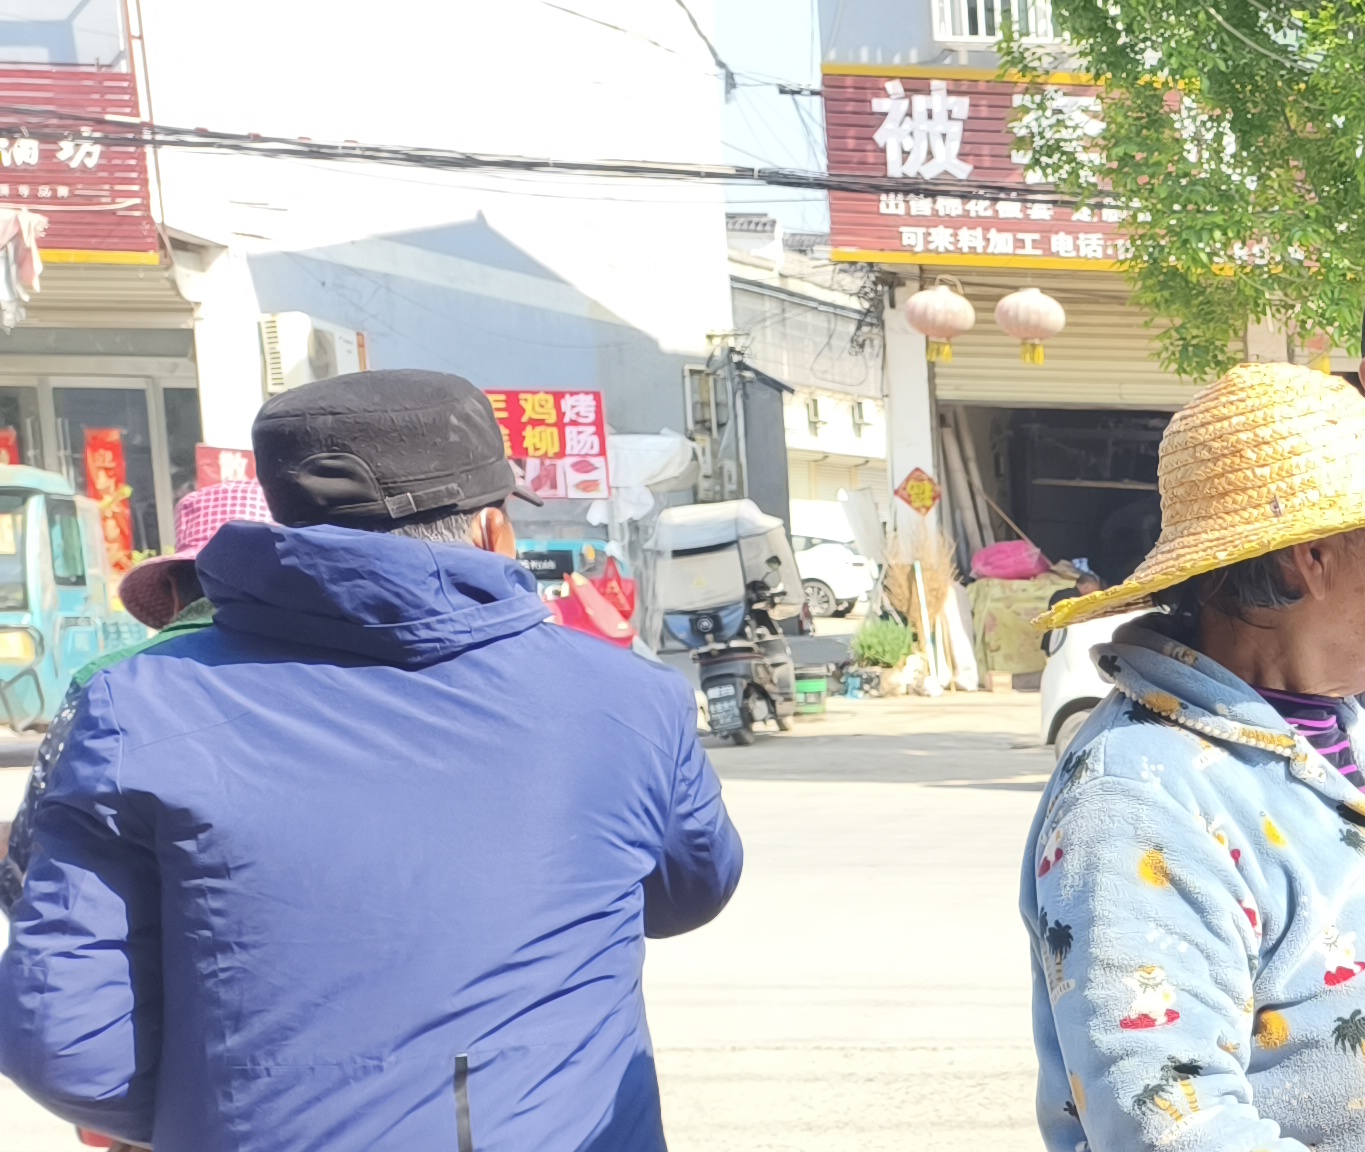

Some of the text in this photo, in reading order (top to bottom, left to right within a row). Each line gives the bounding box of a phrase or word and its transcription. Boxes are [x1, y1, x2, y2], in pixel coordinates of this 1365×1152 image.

[899, 226, 1044, 255] 可来料加工
[560, 392, 600, 456] 烤肠
